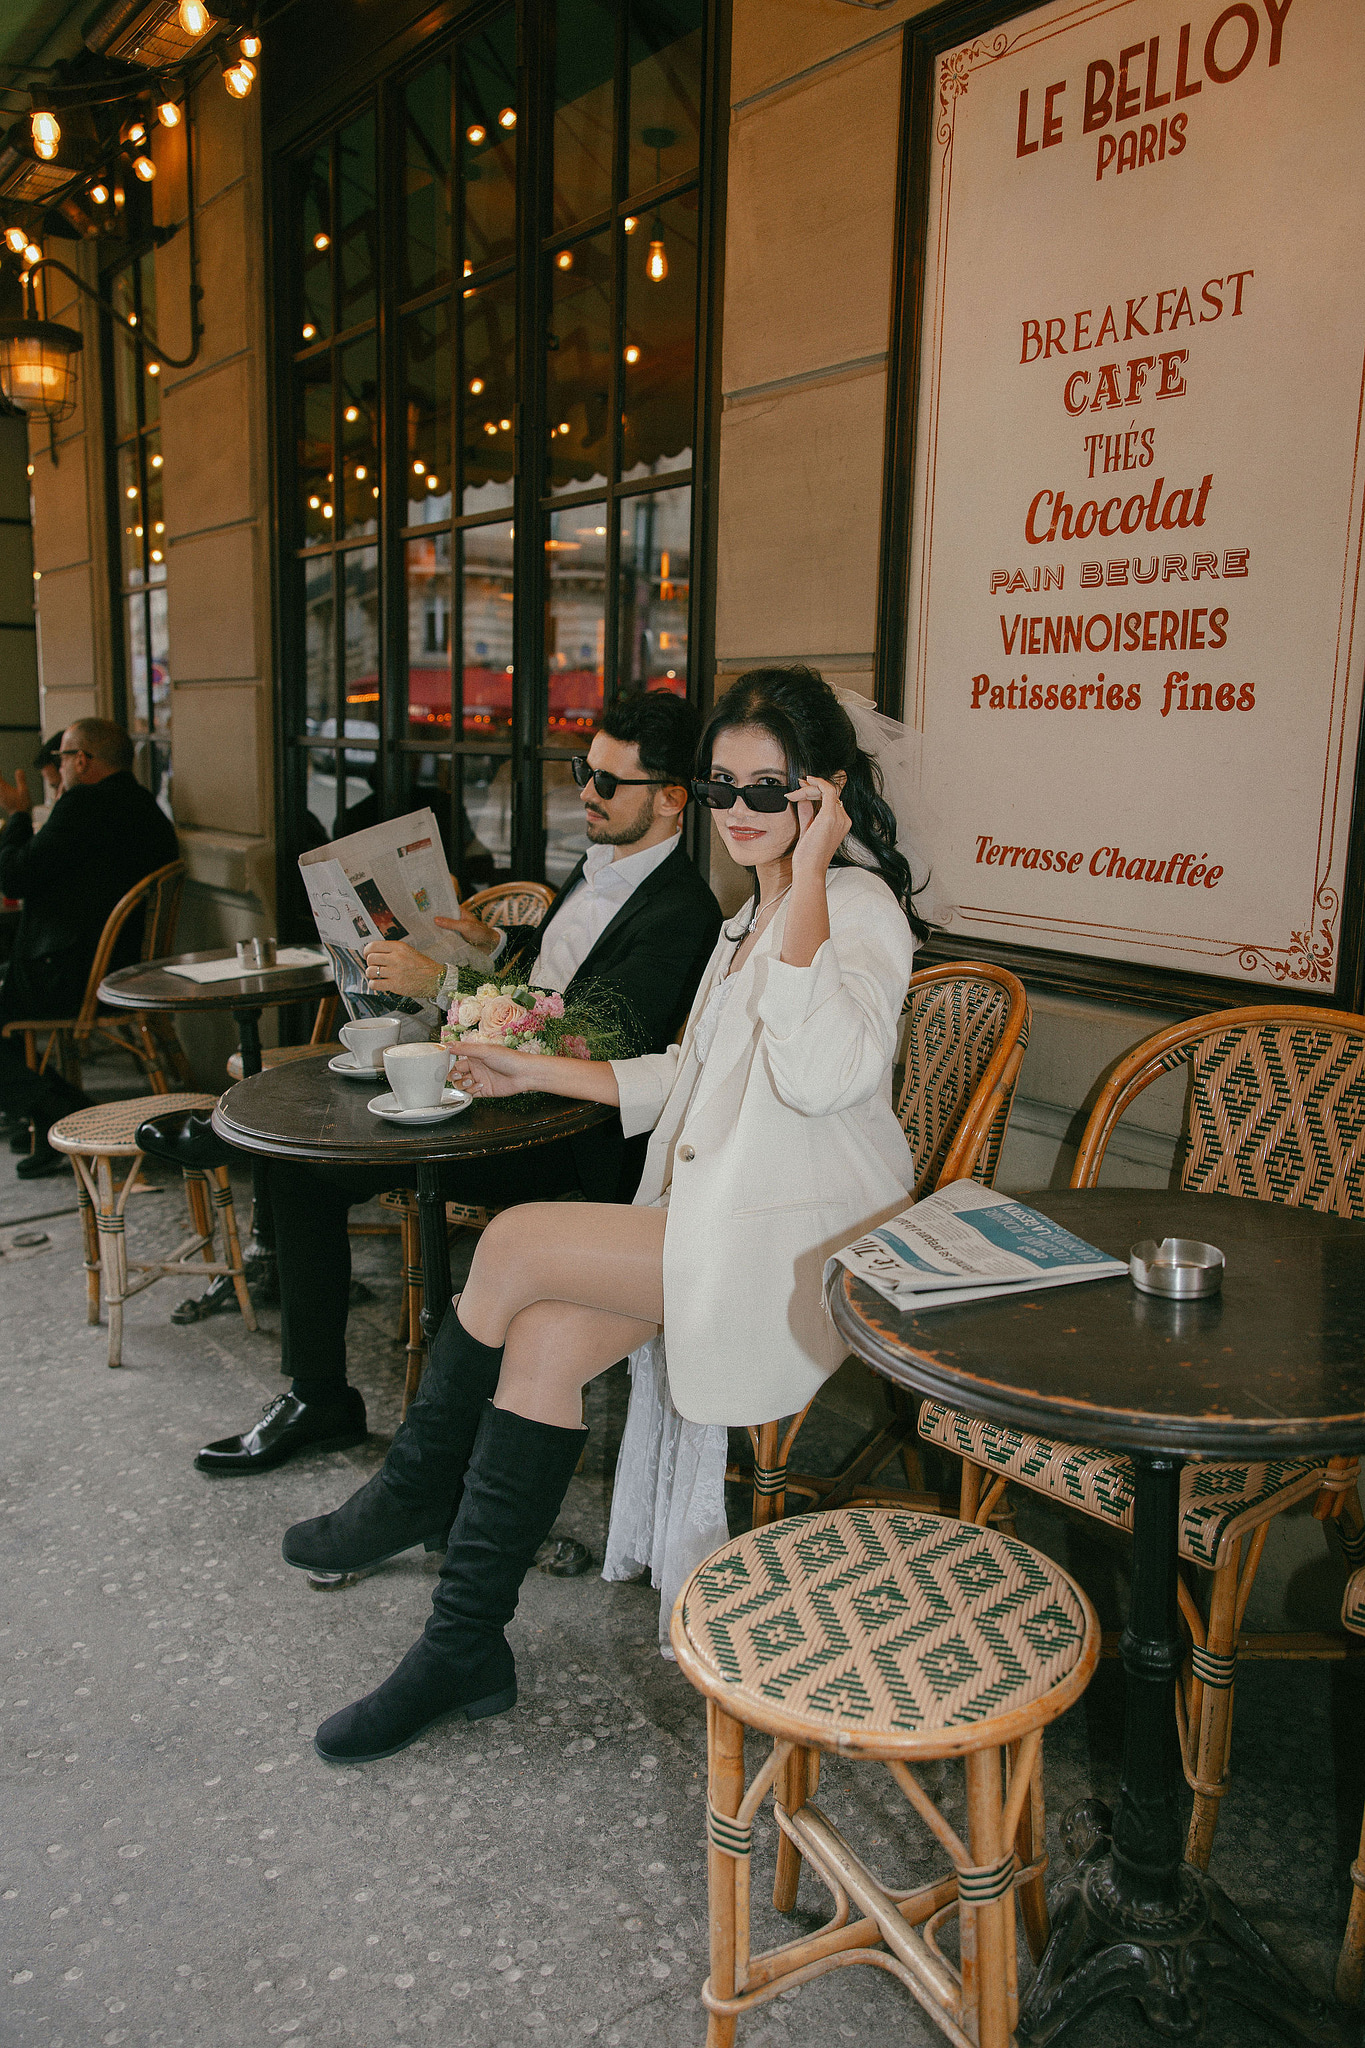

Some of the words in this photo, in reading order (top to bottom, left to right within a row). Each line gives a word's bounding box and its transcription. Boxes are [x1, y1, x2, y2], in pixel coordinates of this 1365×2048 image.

[1016, 80, 1067, 159] LE
[1082, 0, 1296, 135] BELLOY
[1096, 112, 1189, 181] PARIS
[1019, 269, 1255, 364] BREAKFAST
[1063, 348, 1190, 417] CAFE
[1083, 419, 1156, 479] THÉS
[1024, 473, 1214, 545] Chocolat
[989, 563, 1065, 595] PAIN
[1080, 547, 1251, 588] BEURRE
[999, 607, 1230, 656] VIENNOISERIES
[970, 673, 1142, 711] Patisseries
[1160, 671, 1256, 717] fines
[975, 835, 1083, 875] Terrasse
[1089, 846, 1224, 890] Chauffée
